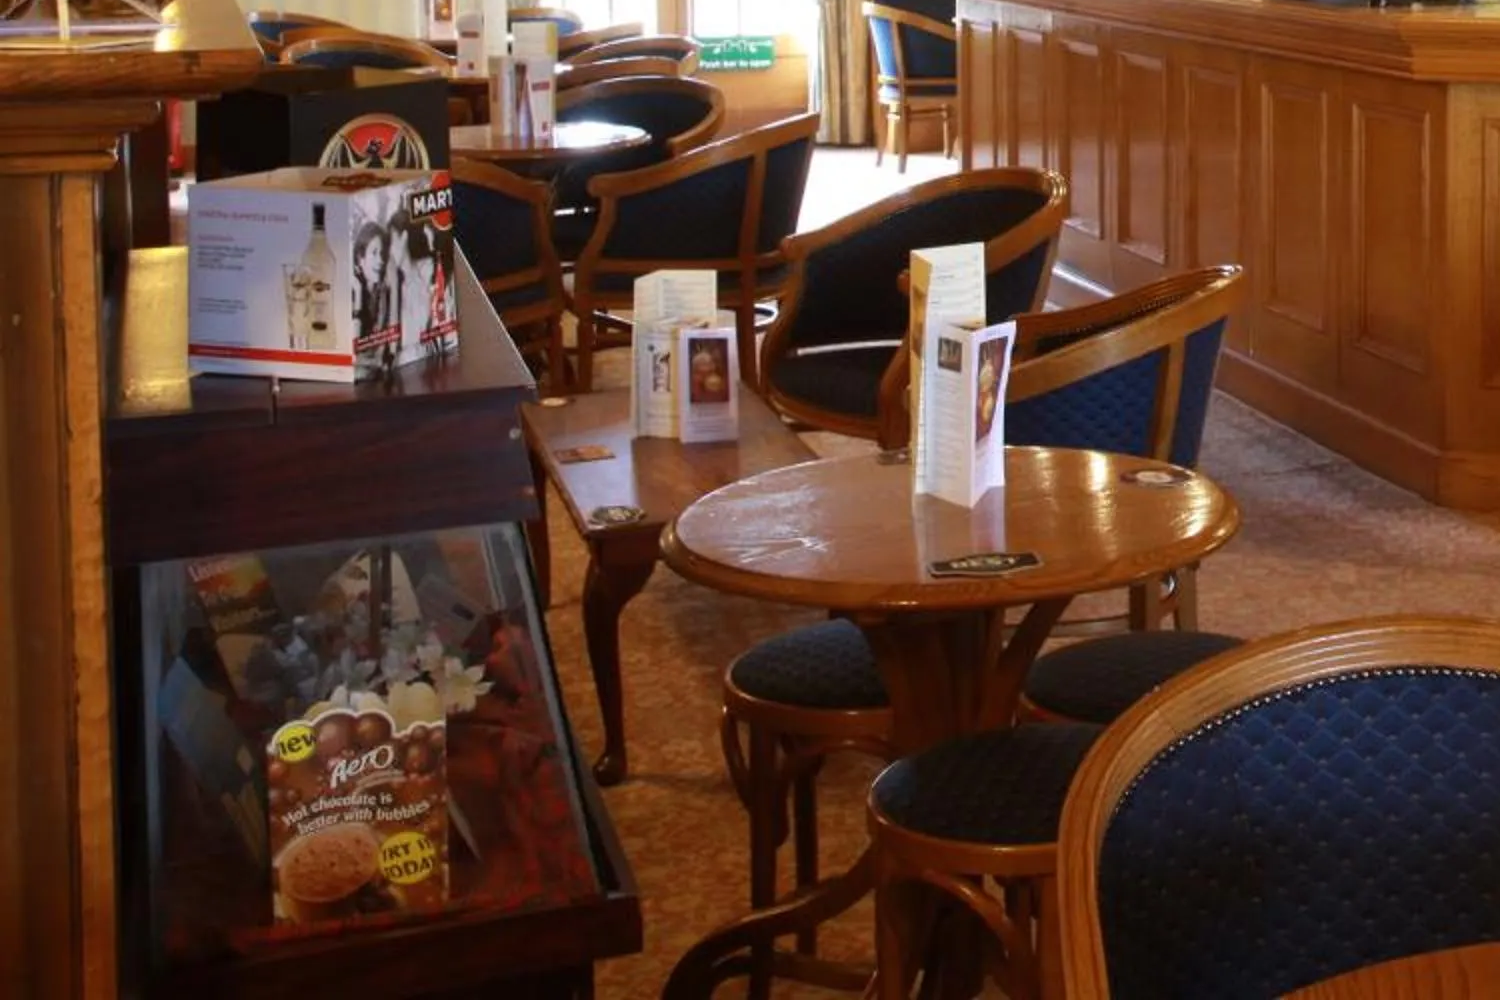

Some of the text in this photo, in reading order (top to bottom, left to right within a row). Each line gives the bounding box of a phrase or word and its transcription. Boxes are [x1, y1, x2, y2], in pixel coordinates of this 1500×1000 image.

[330, 745, 395, 788] Aero
[282, 792, 393, 827] Hot chocolate is
[297, 800, 430, 835] better with bubbles
